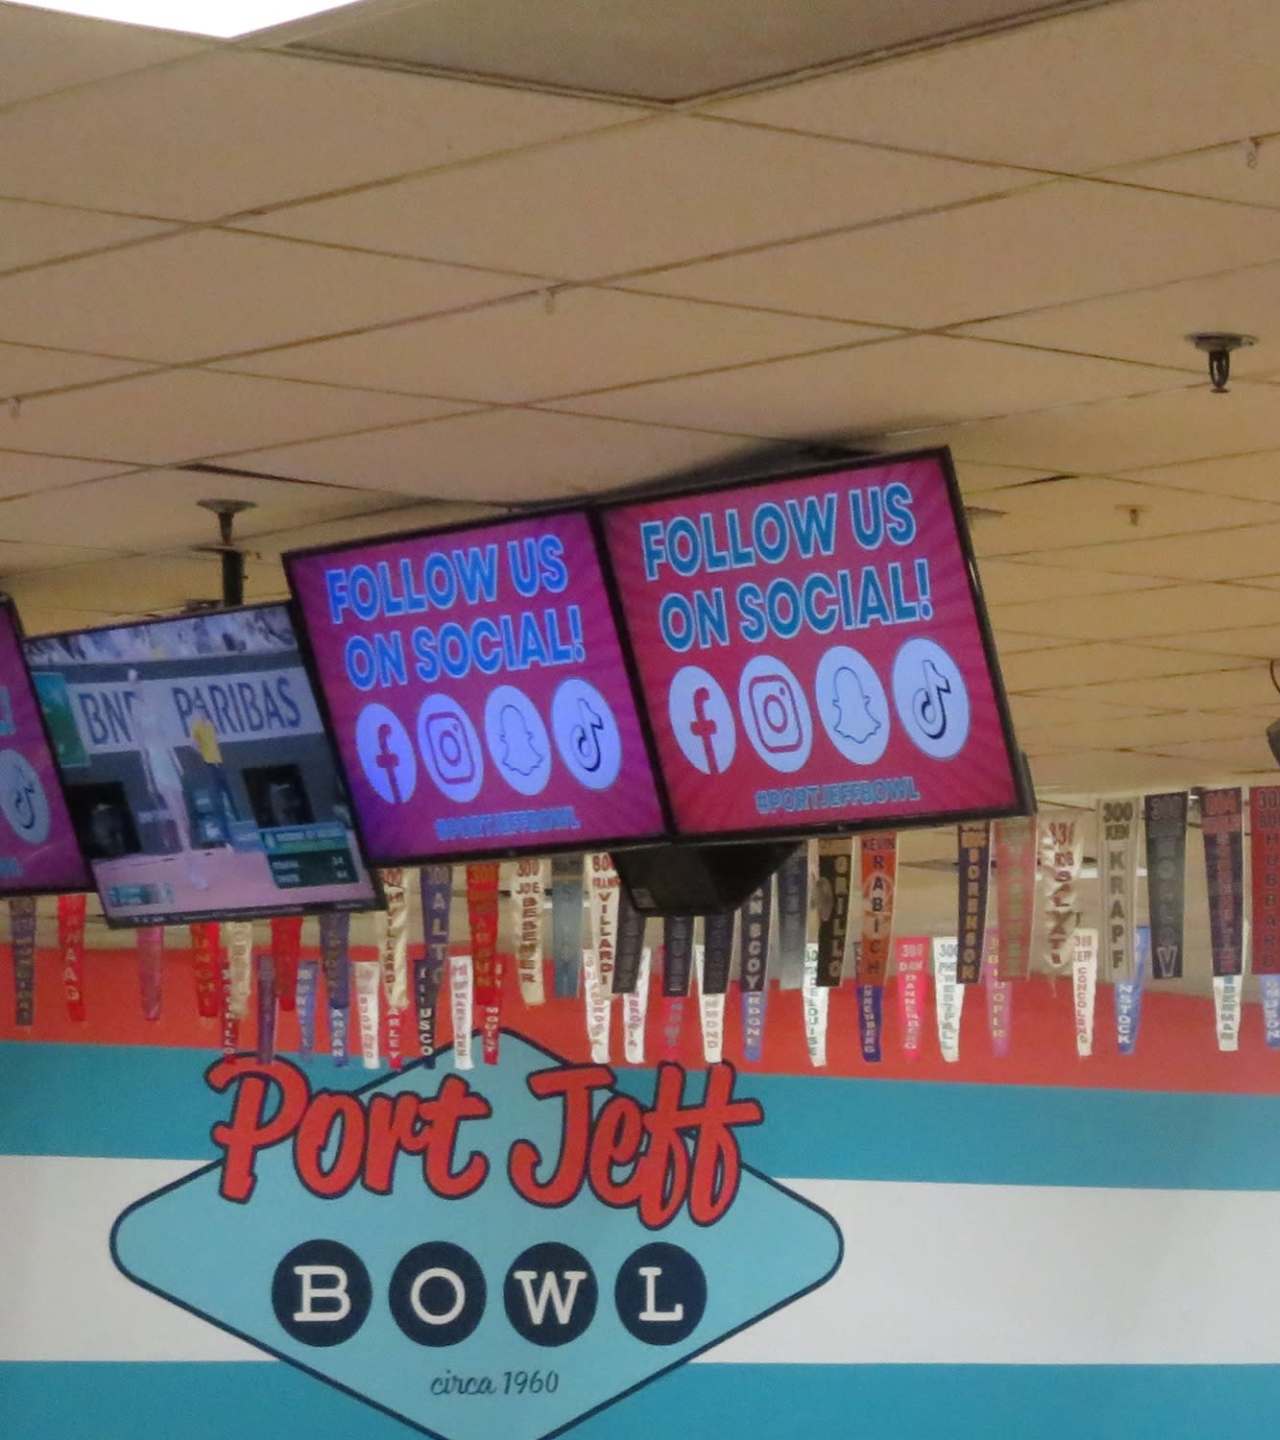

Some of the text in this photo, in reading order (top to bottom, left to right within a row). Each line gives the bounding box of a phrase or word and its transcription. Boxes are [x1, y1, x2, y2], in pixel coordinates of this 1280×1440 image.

[640, 482, 916, 581] FOLLOW US
[326, 535, 567, 624] FOLLOW US
[659, 559, 933, 652] ON SOCIAL!
[347, 606, 585, 691] ON SOCIAL!
[1103, 802, 1134, 823] 300
[867, 855, 885, 974] RABICH
[1109, 851, 1124, 969] KRAPF
[205, 1053, 765, 1230] Port Jeff
[292, 1264, 684, 1327] BOWL
[430, 1367, 560, 1398] circa 1960
